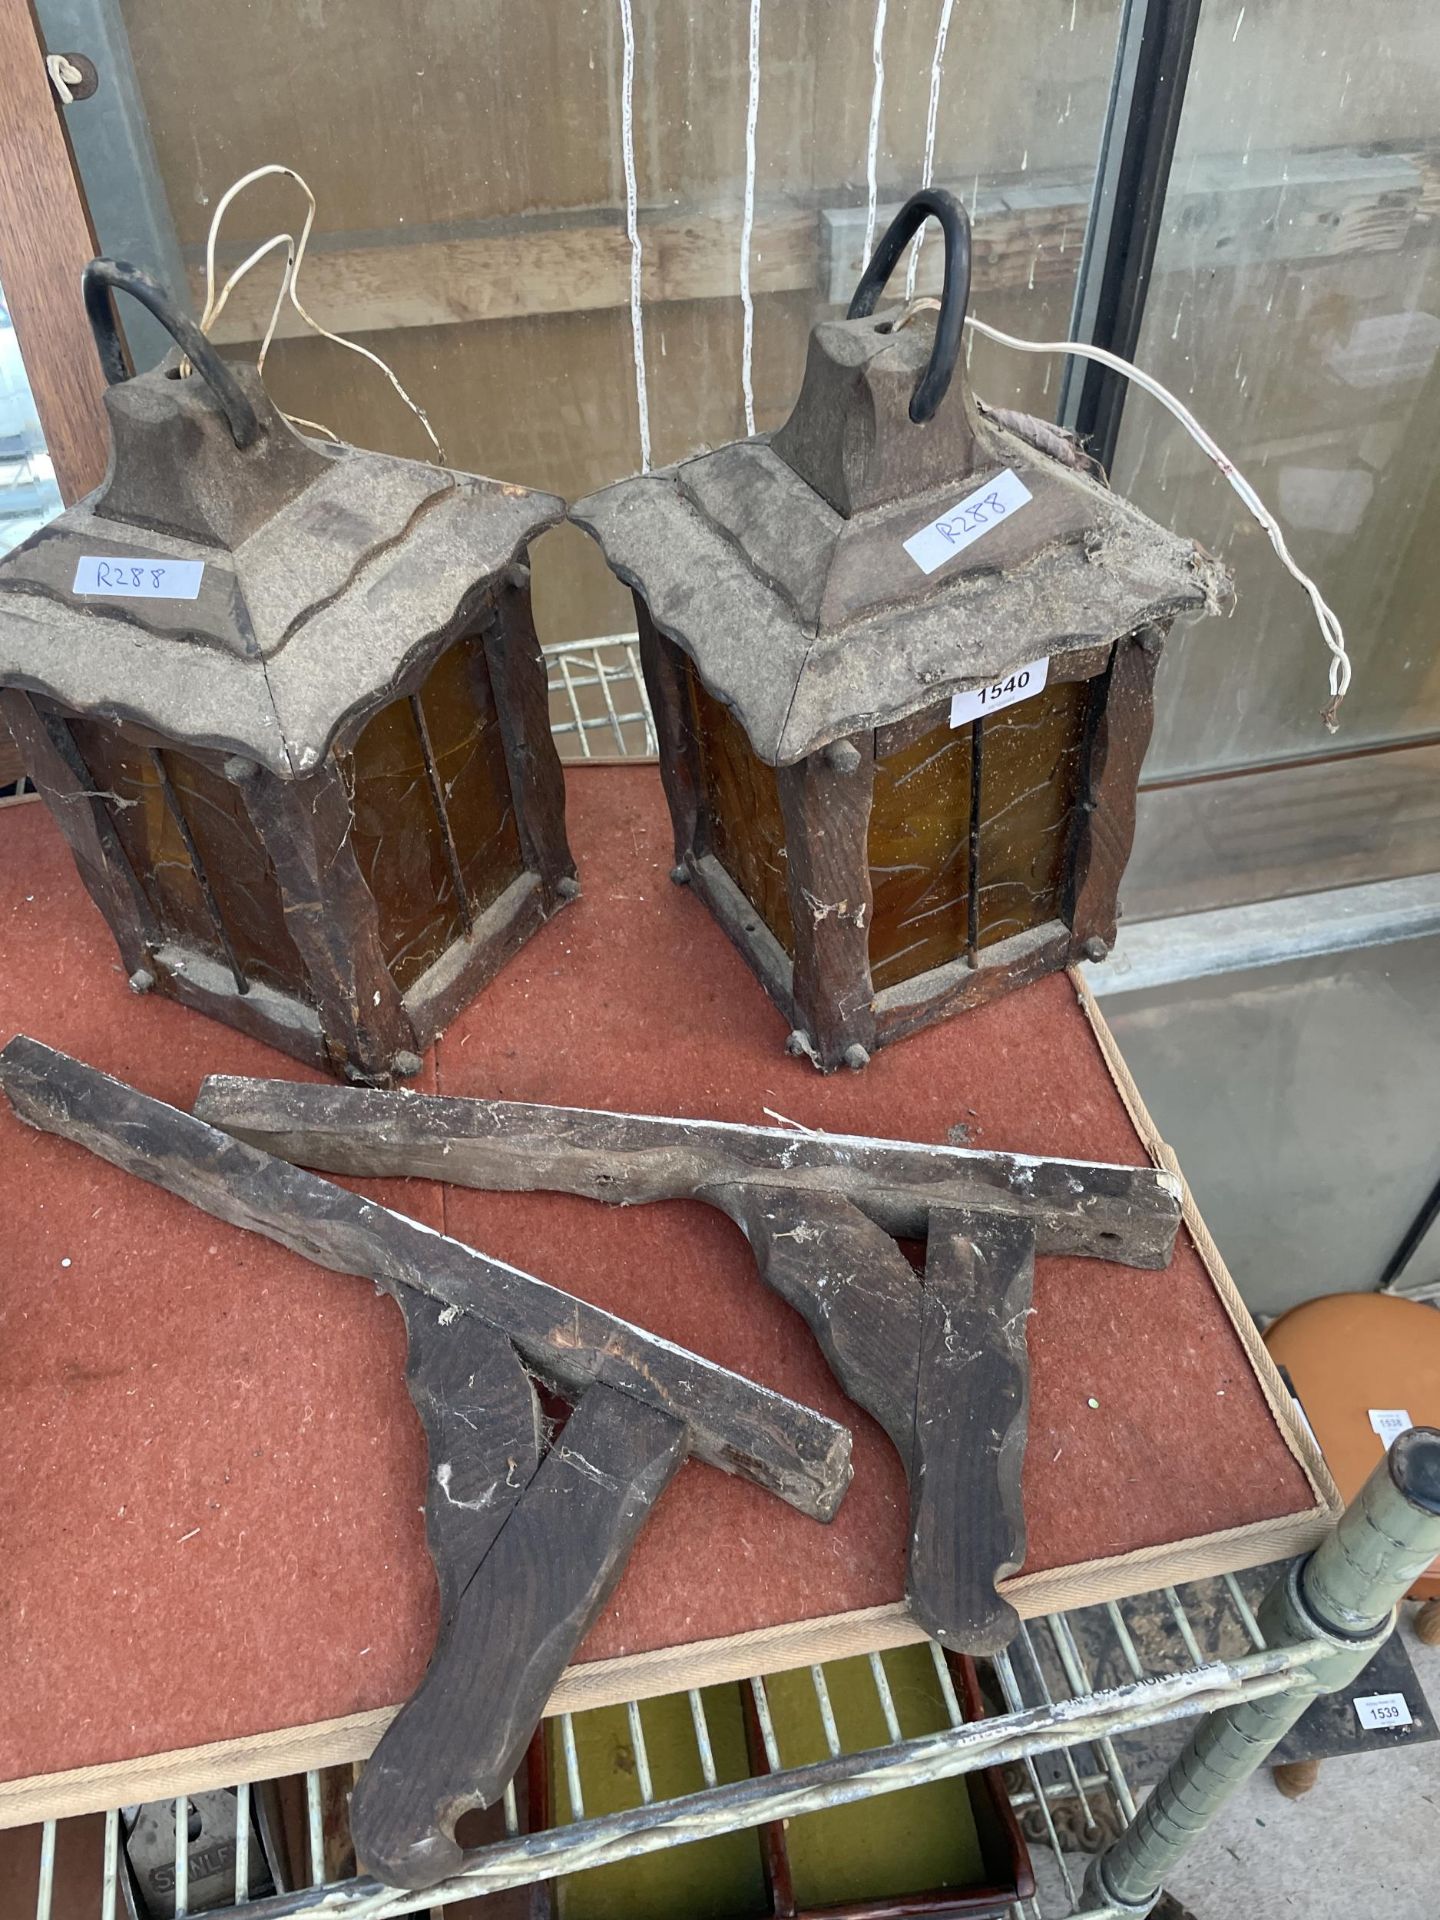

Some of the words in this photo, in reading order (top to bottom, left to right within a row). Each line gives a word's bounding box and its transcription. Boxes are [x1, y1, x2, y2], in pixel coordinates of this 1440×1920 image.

[935, 492, 1006, 544] R288
[97, 561, 166, 589] R288
[977, 671, 1030, 704] 1540
[1370, 1706, 1400, 1720] 1539
